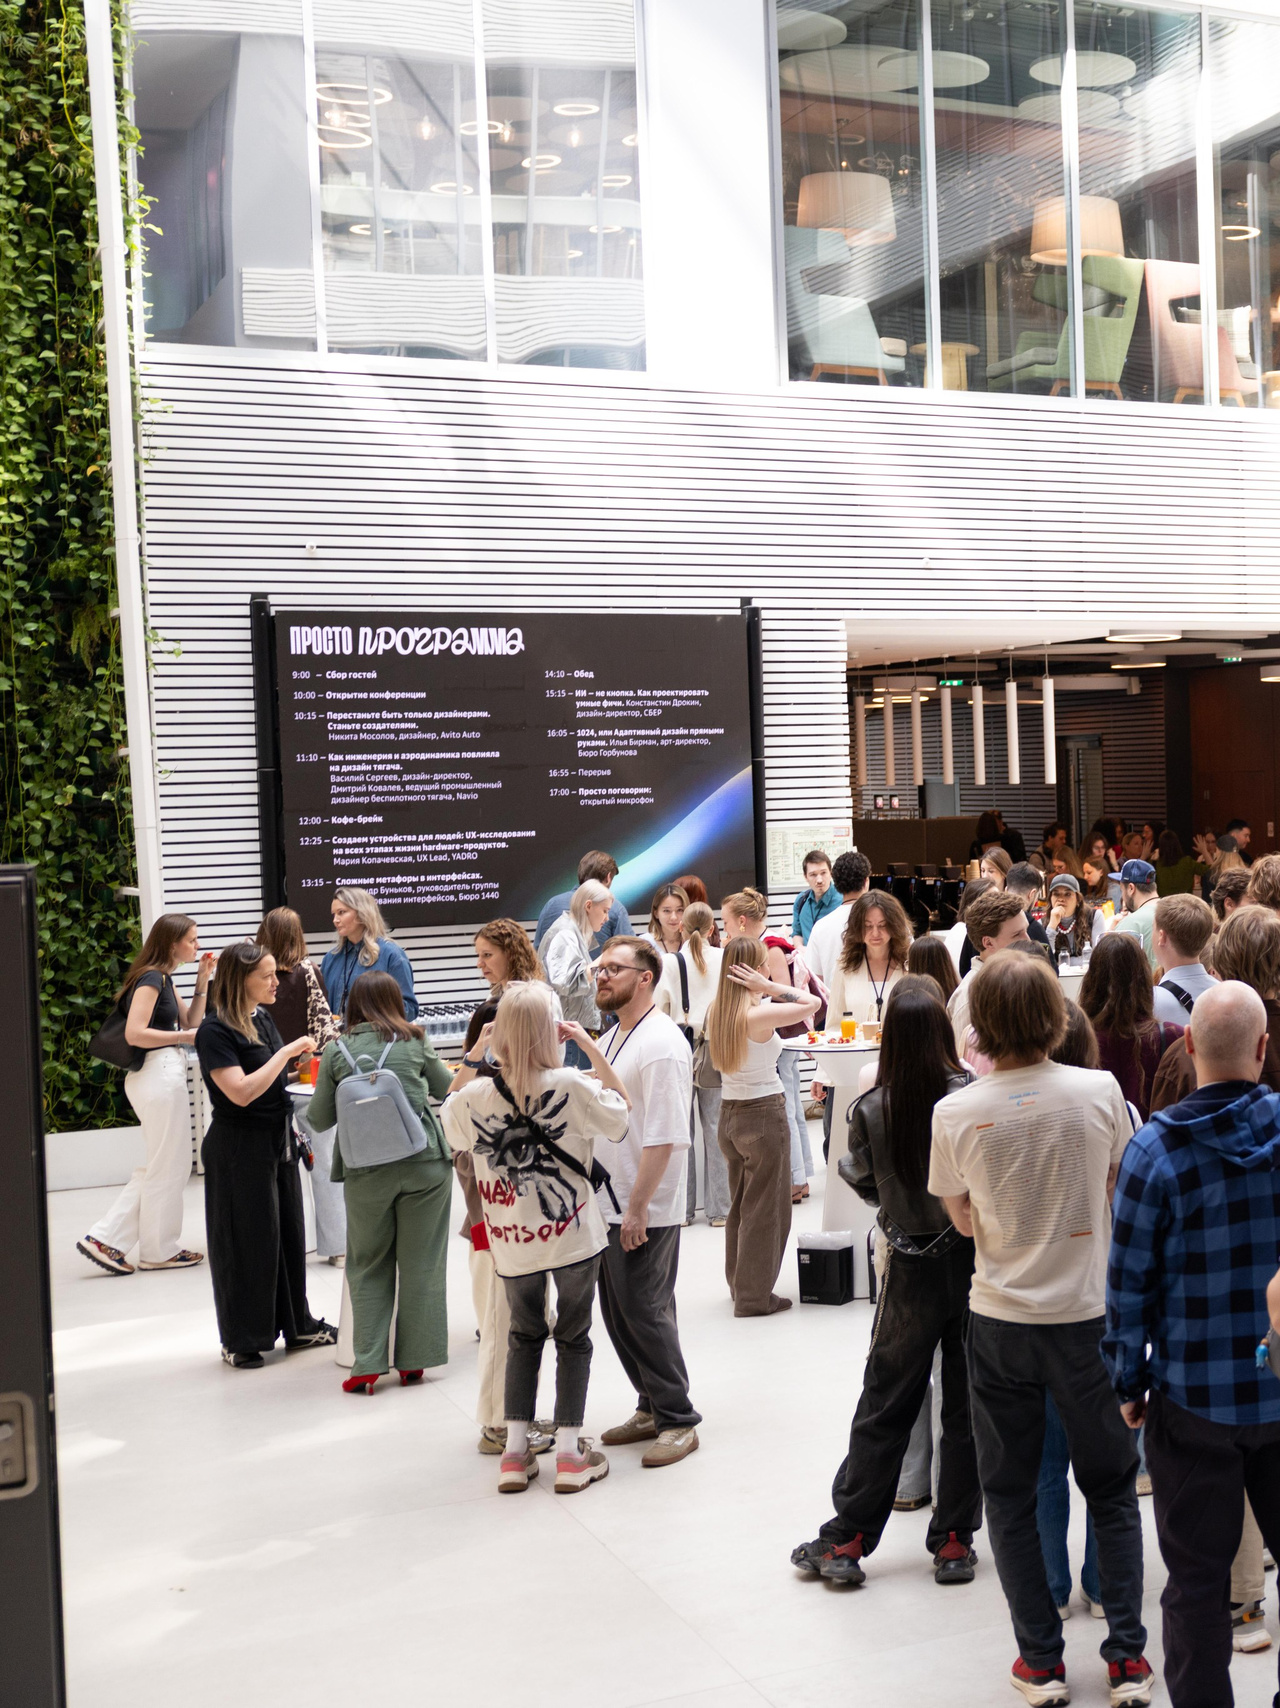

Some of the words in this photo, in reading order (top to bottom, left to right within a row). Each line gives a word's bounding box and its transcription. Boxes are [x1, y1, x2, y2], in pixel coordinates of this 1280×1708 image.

[289, 626, 353, 655] ПРОСТО
[292, 670, 310, 678] 9:00
[326, 670, 347, 680] Сбор
[348, 669, 377, 678] гостей
[545, 669, 565, 678] 14:10
[573, 669, 594, 679] Обед
[294, 690, 316, 699] 10:00
[326, 690, 368, 701] Открытие
[369, 689, 426, 700] конференции
[546, 688, 566, 697] 15:15
[575, 688, 587, 697] ИИ
[637, 688, 652, 696] Как
[652, 689, 709, 698] проектировать
[575, 700, 601, 709] умные
[602, 698, 625, 708] фичи.
[294, 710, 317, 719] 10:15
[326, 710, 381, 721] Перестаньте
[381, 710, 403, 719] быть
[433, 709, 491, 720] дизайнерами.
[576, 707, 642, 719] дизайн-директор,
[644, 707, 662, 716] СБЕР
[328, 720, 361, 730] Станьте
[362, 722, 418, 731] создателями.
[328, 731, 358, 740] Никита
[398, 730, 439, 741] дизайнер,
[440, 730, 461, 739] Avito
[462, 729, 481, 738] Auto
[547, 728, 568, 737] 16:05
[577, 727, 597, 738] 1024,
[613, 726, 661, 738] Адаптивный
[661, 726, 689, 737] дизайн
[689, 727, 724, 736] прямыми
[577, 739, 609, 748] руками.
[609, 737, 628, 746] Илья
[629, 736, 659, 747] Бирман,
[660, 738, 711, 747] арт-директор,
[296, 753, 318, 762] 11:10
[328, 752, 344, 761] Как
[345, 753, 393, 763] инженерия
[400, 752, 461, 761] аэродинамика
[578, 748, 598, 759] Бюро
[600, 747, 637, 758] Горбунова
[341, 761, 372, 773] дизайн
[549, 767, 569, 776] 16:55
[578, 767, 611, 778] Перерыв
[330, 772, 365, 782] Василий
[366, 772, 401, 783] Сергеев,
[402, 770, 473, 782] дизайн-директор,
[330, 783, 367, 794] Дмитрий
[368, 782, 404, 793] Ковалев,
[405, 781, 440, 792] ведущий
[441, 779, 502, 792] промышленный
[550, 787, 569, 796] 17:00
[579, 786, 606, 797] Просто
[608, 786, 651, 797] поговорим:
[331, 793, 370, 805] дизайнер
[370, 792, 426, 802] беспилотного
[427, 793, 455, 802] тягача,
[456, 790, 478, 800] Navio
[580, 795, 615, 807] открытый
[617, 794, 654, 806] микрофон
[300, 815, 321, 825] 12:00
[332, 813, 383, 826] Кофе-брейк
[299, 835, 322, 845] 12:25
[332, 834, 369, 846] Создаем
[369, 832, 417, 844] устройства
[417, 834, 434, 843] для
[434, 830, 464, 842] людей:
[465, 828, 536, 841] UX-исследования
[395, 844, 421, 852] жизни
[422, 839, 508, 853] hardware-продуктов.
[333, 855, 360, 867] Мария
[416, 852, 428, 862] UX
[429, 852, 450, 863] Lead,
[451, 851, 478, 860] YADRO
[301, 877, 324, 886] 13:15
[335, 874, 375, 885] Сложные
[376, 873, 419, 885] метафоры
[426, 870, 483, 883] интерфейсах.
[416, 883, 471, 894] руководитель
[471, 882, 499, 892] группы
[403, 891, 457, 904] интерфейсов,
[459, 891, 480, 902] Бюро
[481, 890, 499, 900] 1440
